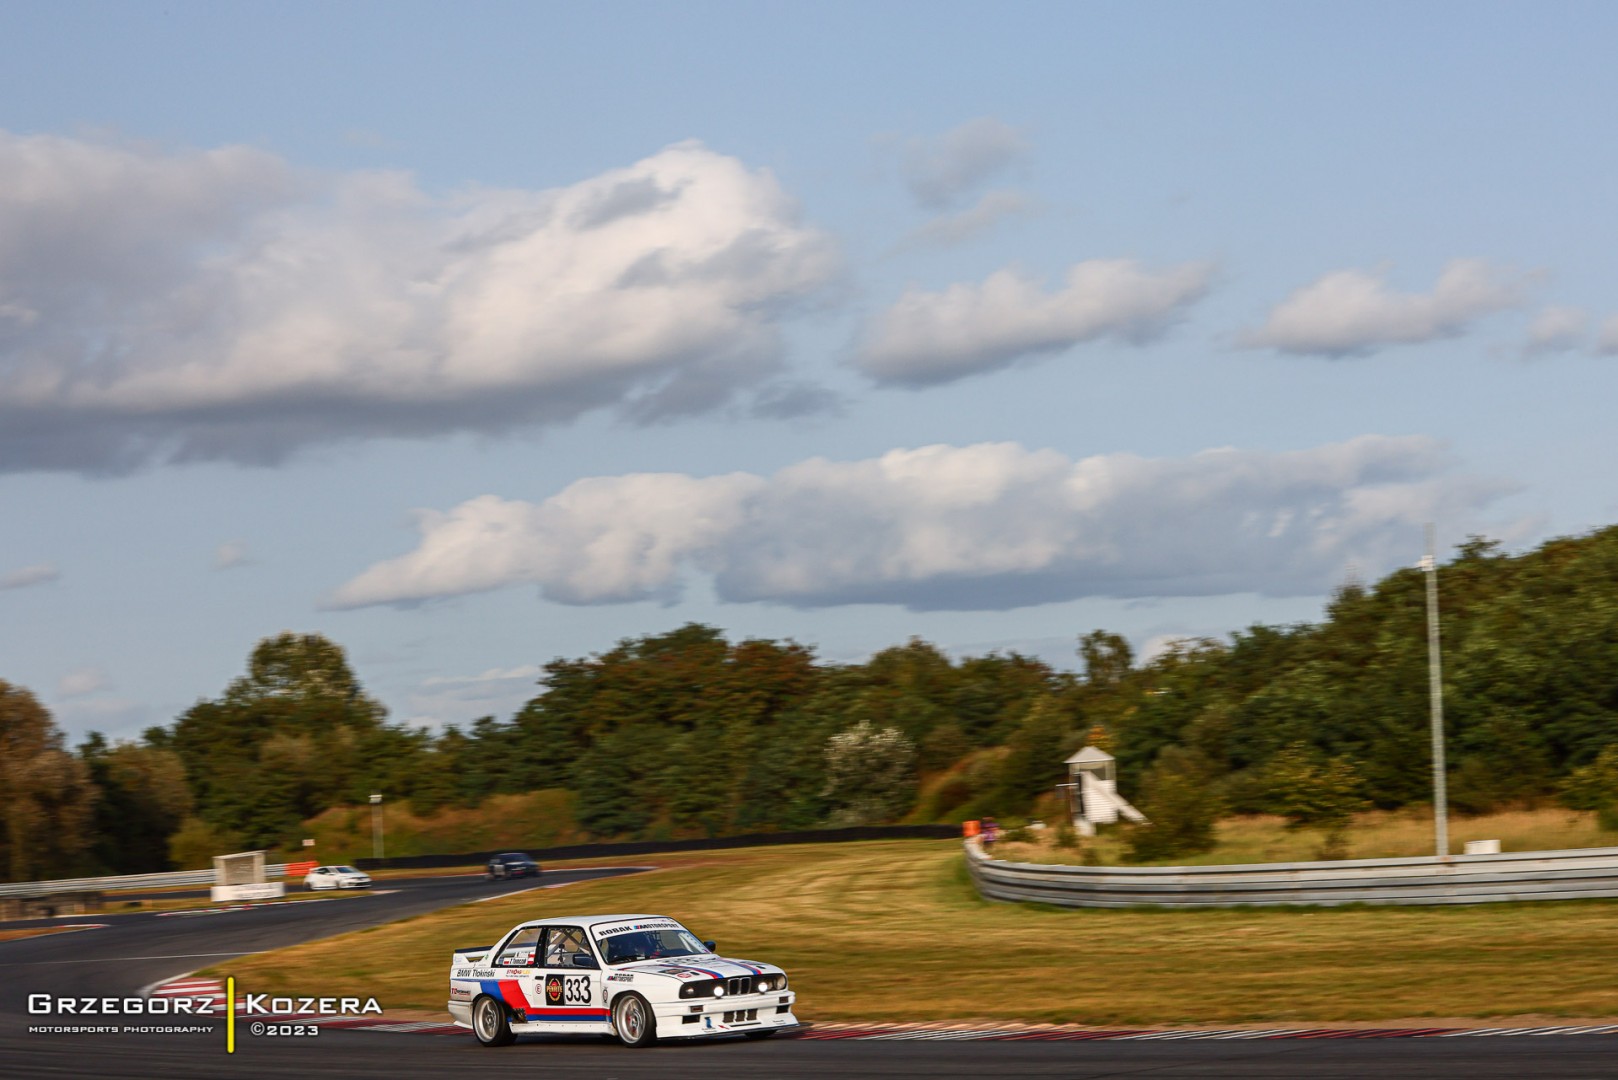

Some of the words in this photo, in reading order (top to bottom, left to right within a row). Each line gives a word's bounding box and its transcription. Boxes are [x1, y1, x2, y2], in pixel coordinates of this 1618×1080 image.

[599, 926, 632, 936] ROBAK
[456, 969, 471, 978] BMW
[565, 975, 592, 1004] 333
